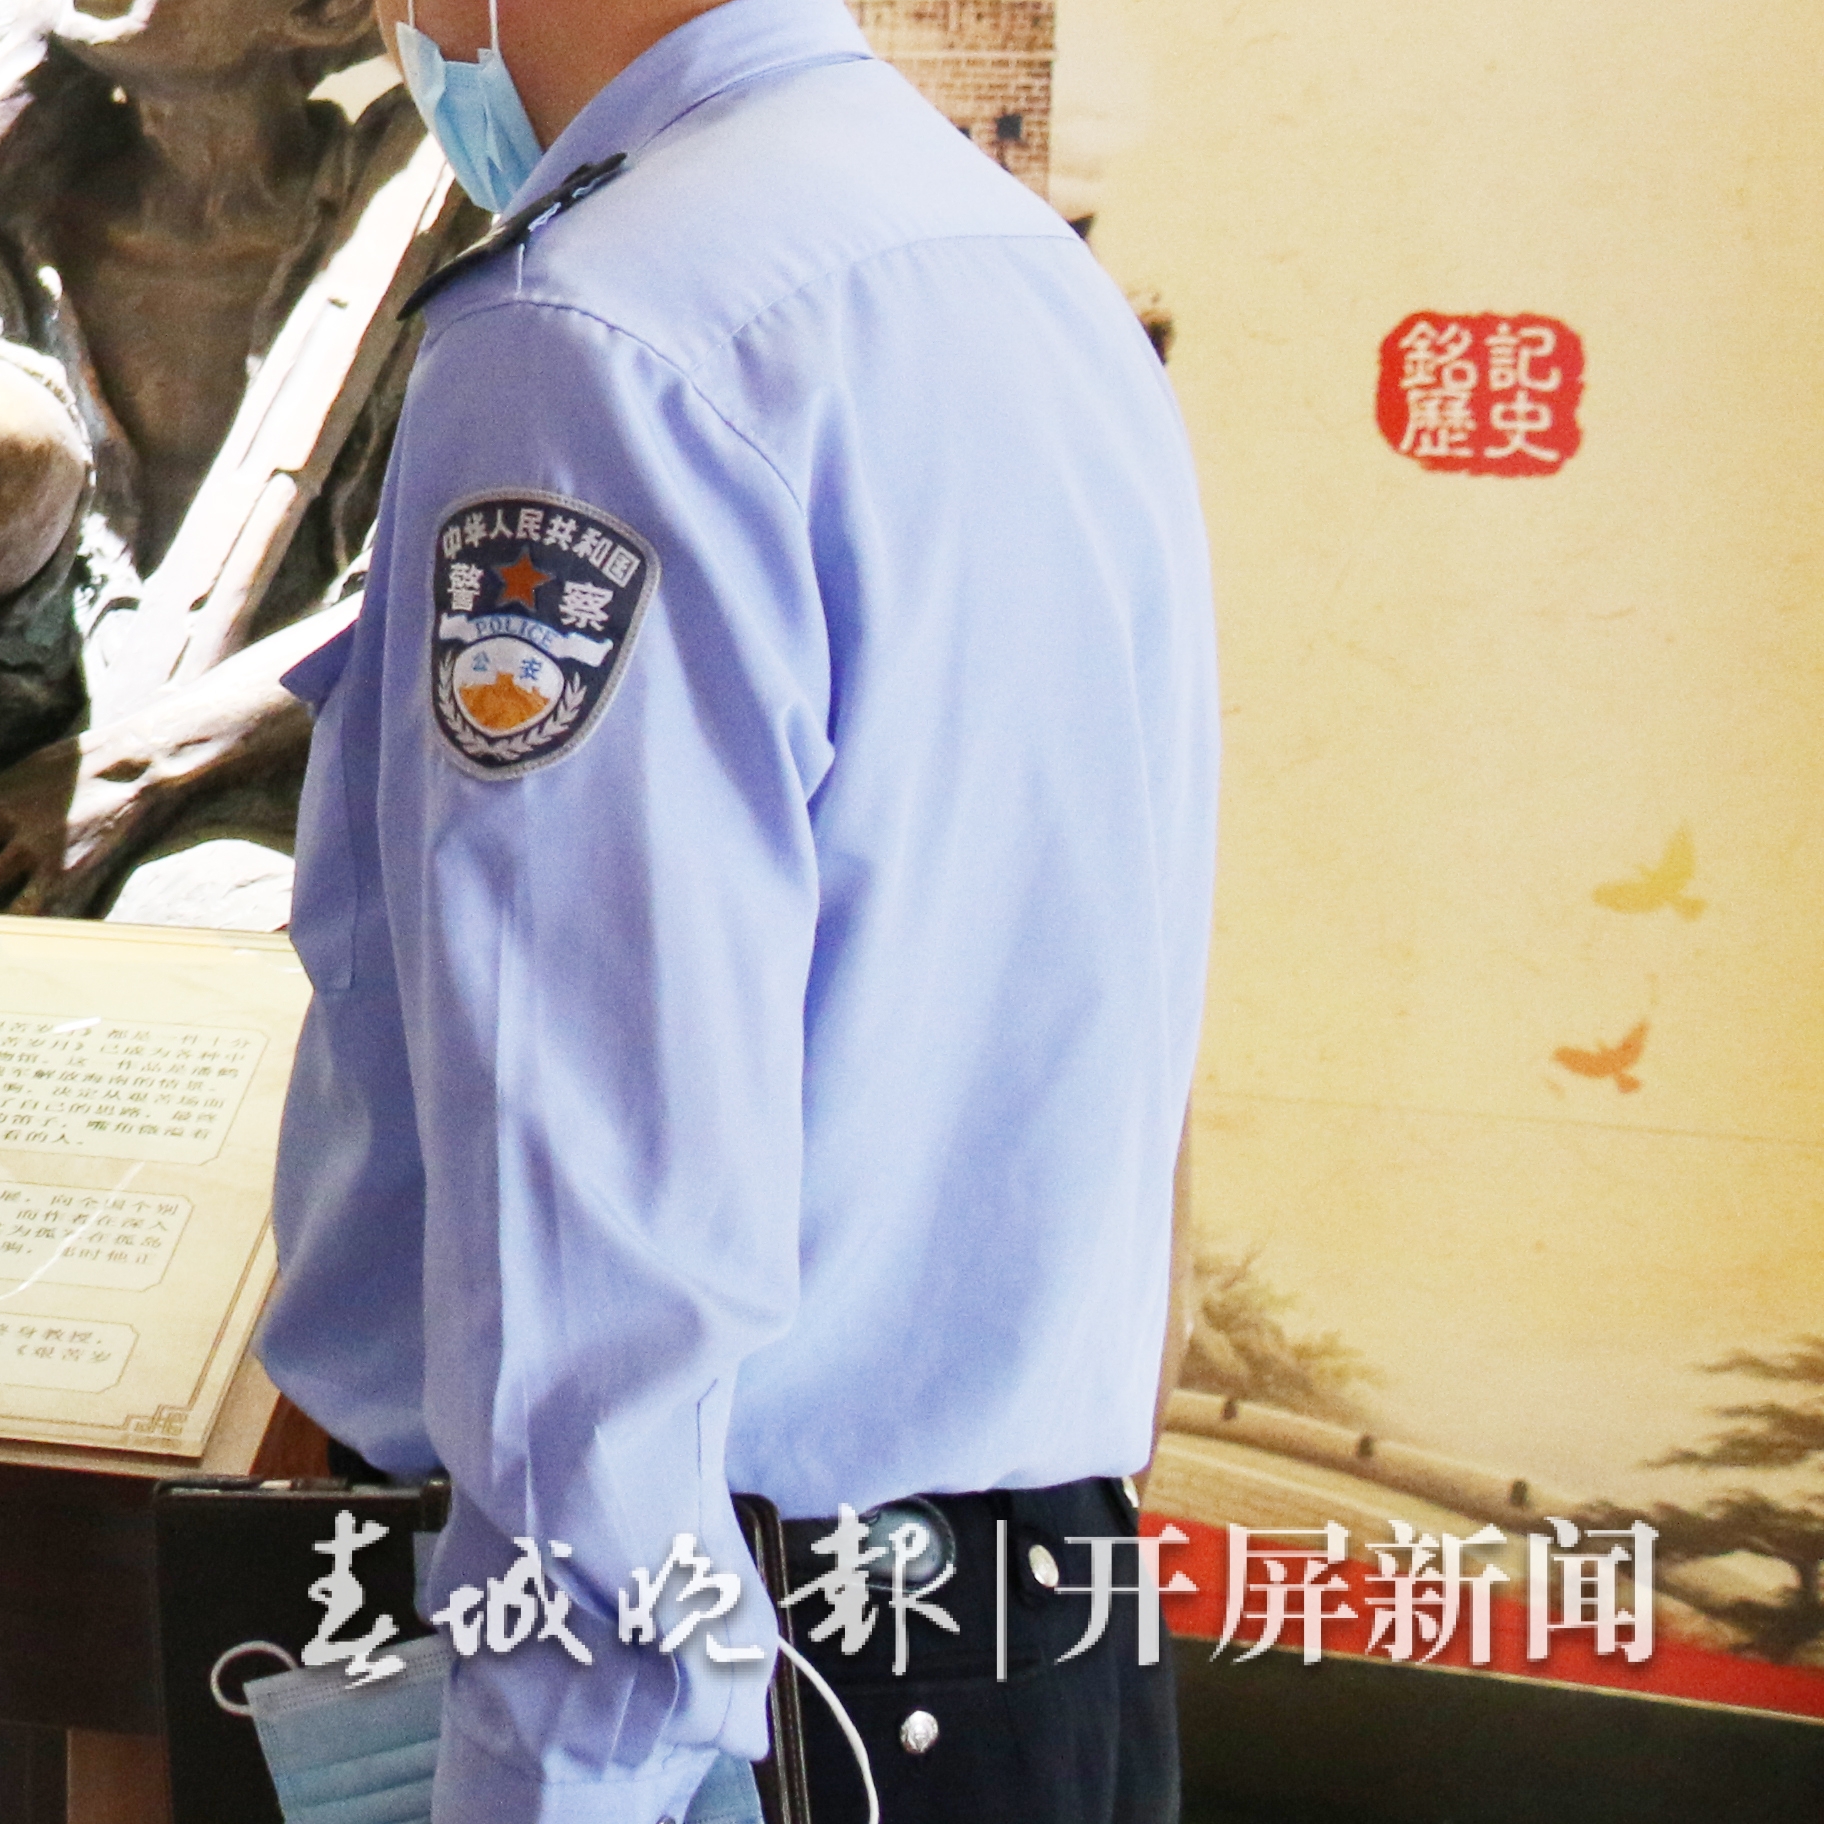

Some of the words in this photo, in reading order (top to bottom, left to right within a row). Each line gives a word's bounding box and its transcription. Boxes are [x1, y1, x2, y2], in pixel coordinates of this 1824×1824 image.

[1398, 319, 1562, 393] 銘記
[442, 508, 641, 588] 中华人民共和国
[475, 619, 559, 651] POLICE
